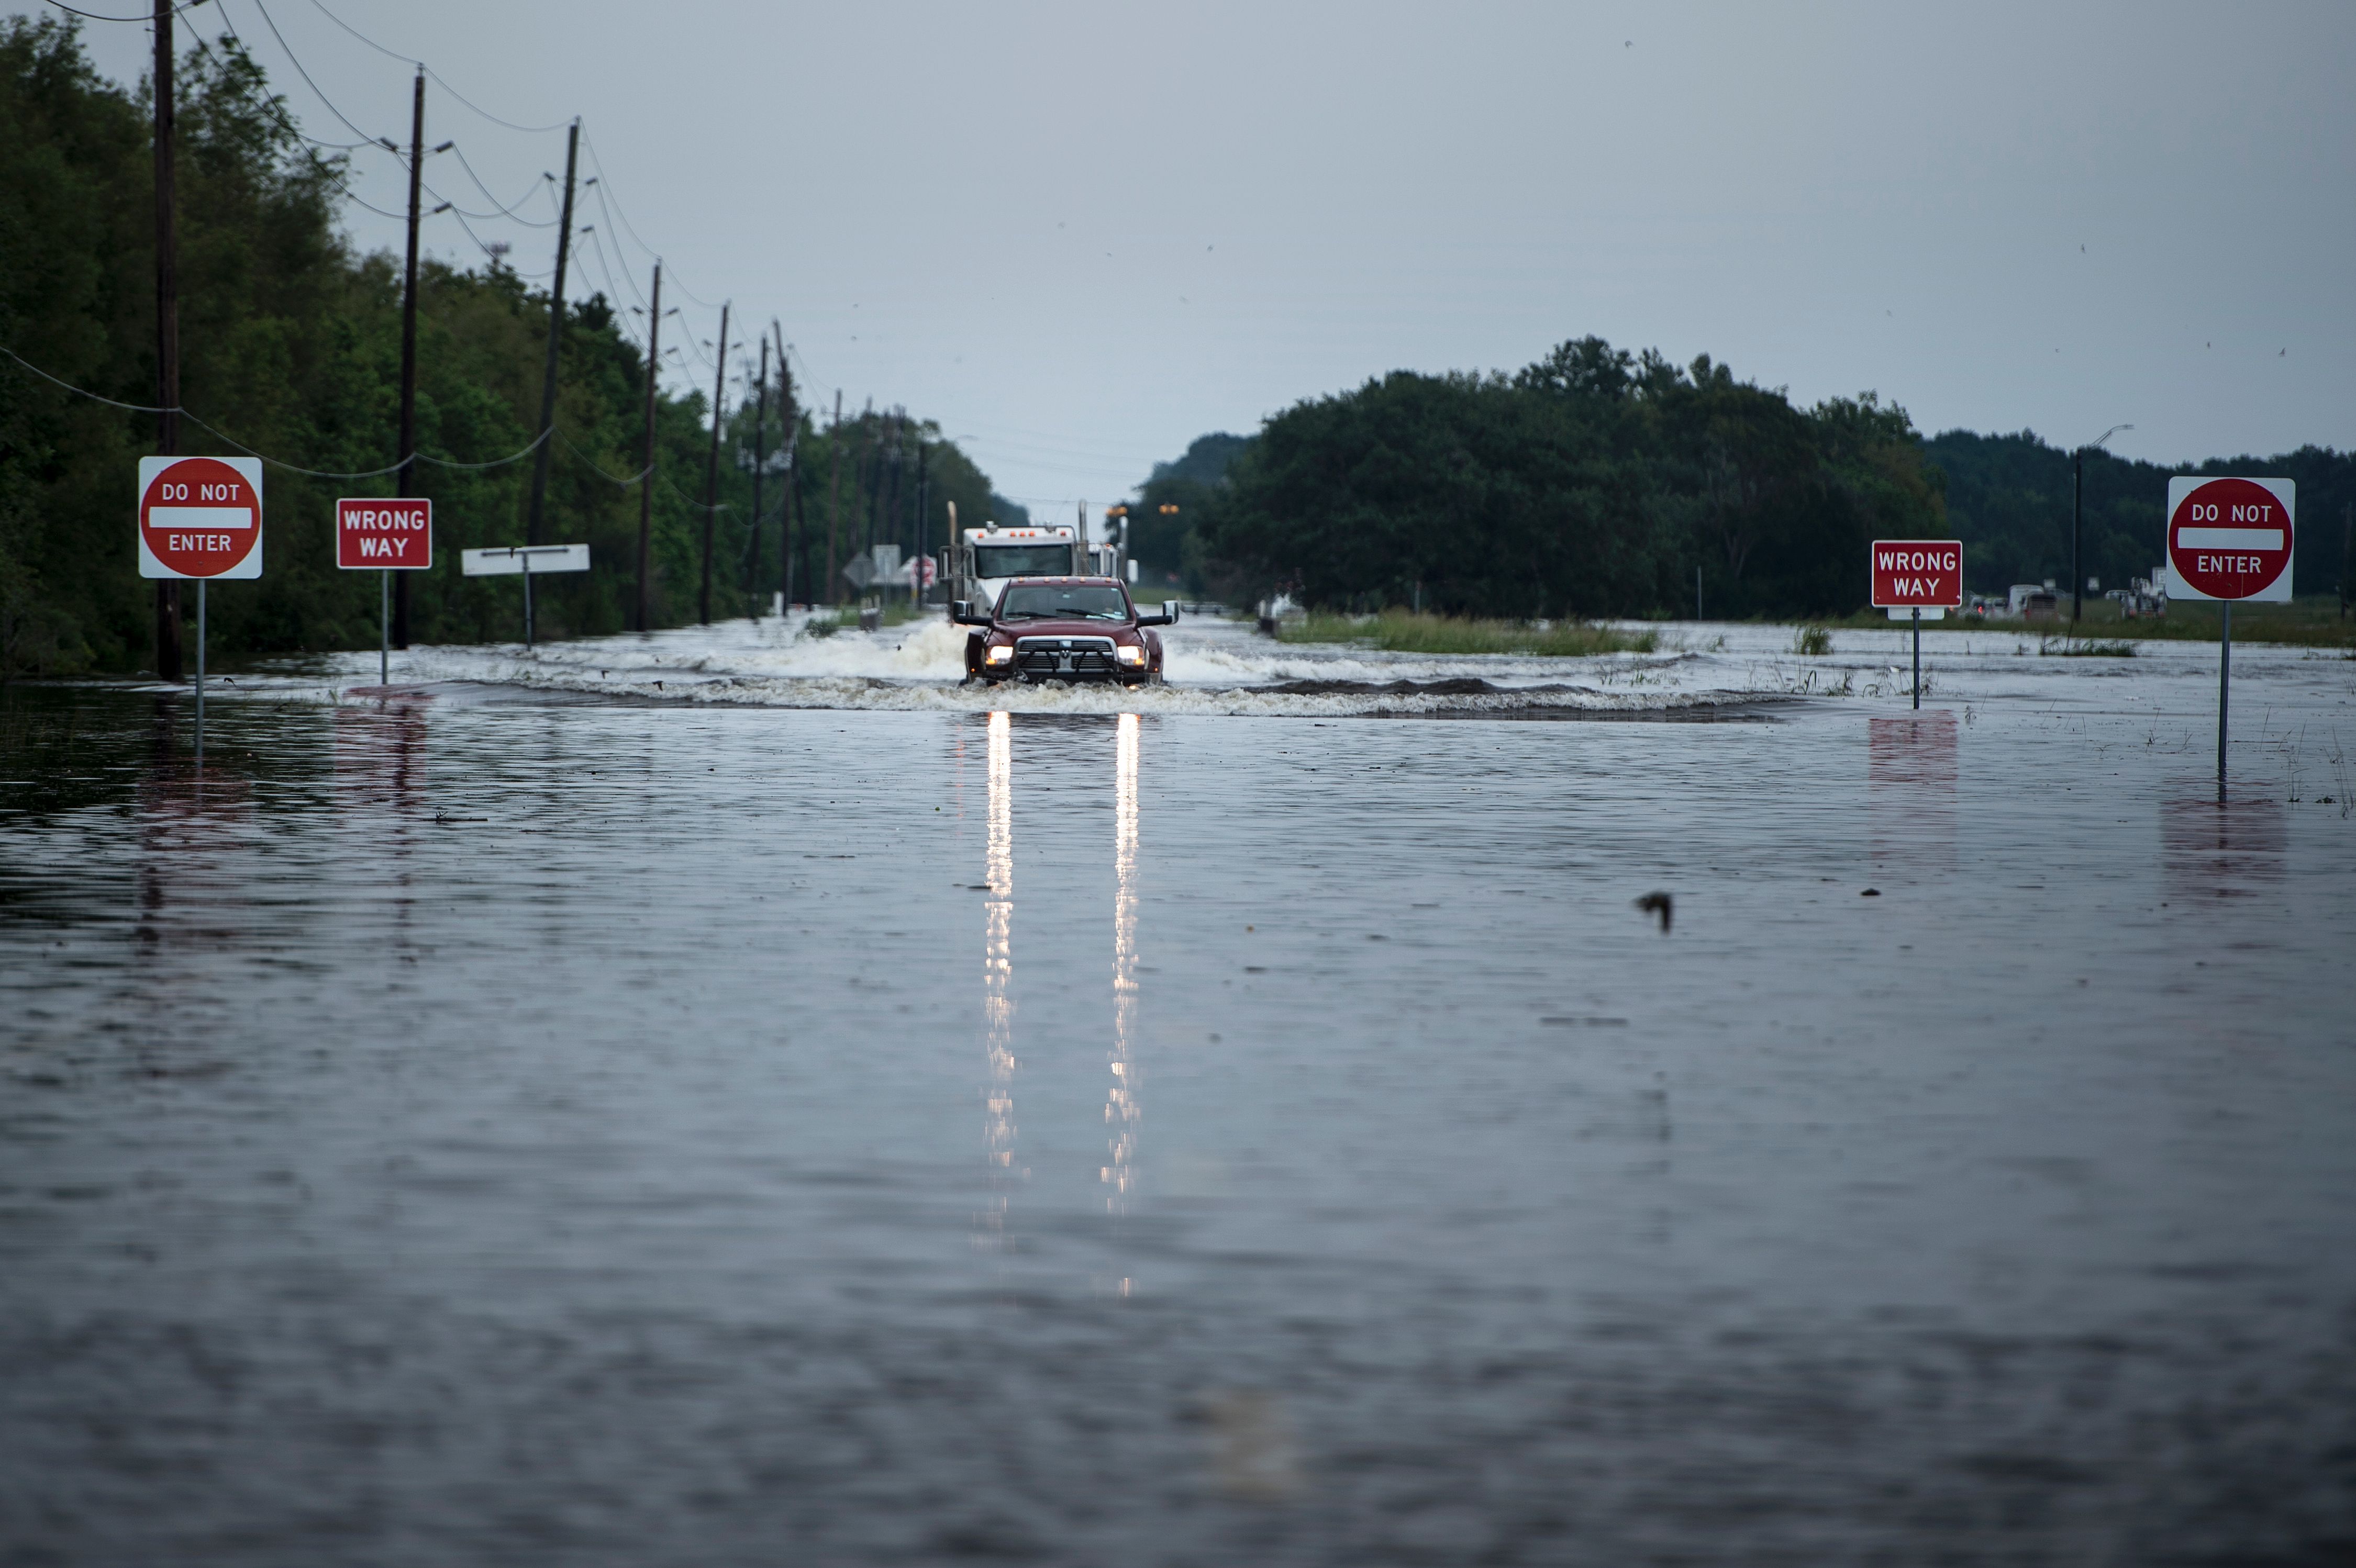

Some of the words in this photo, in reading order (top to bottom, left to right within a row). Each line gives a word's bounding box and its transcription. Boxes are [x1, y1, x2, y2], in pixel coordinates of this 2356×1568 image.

[162, 483, 188, 501] DO
[201, 484, 240, 501] NOT
[344, 510, 424, 530] WRONG
[2192, 504, 2219, 522] DO
[2232, 505, 2272, 522] NOT
[169, 534, 231, 551] ENTER
[360, 537, 408, 557] WAY
[1879, 552, 1956, 571] WRONG
[2198, 555, 2261, 573] ENTER
[1894, 577, 1940, 596] WAY
